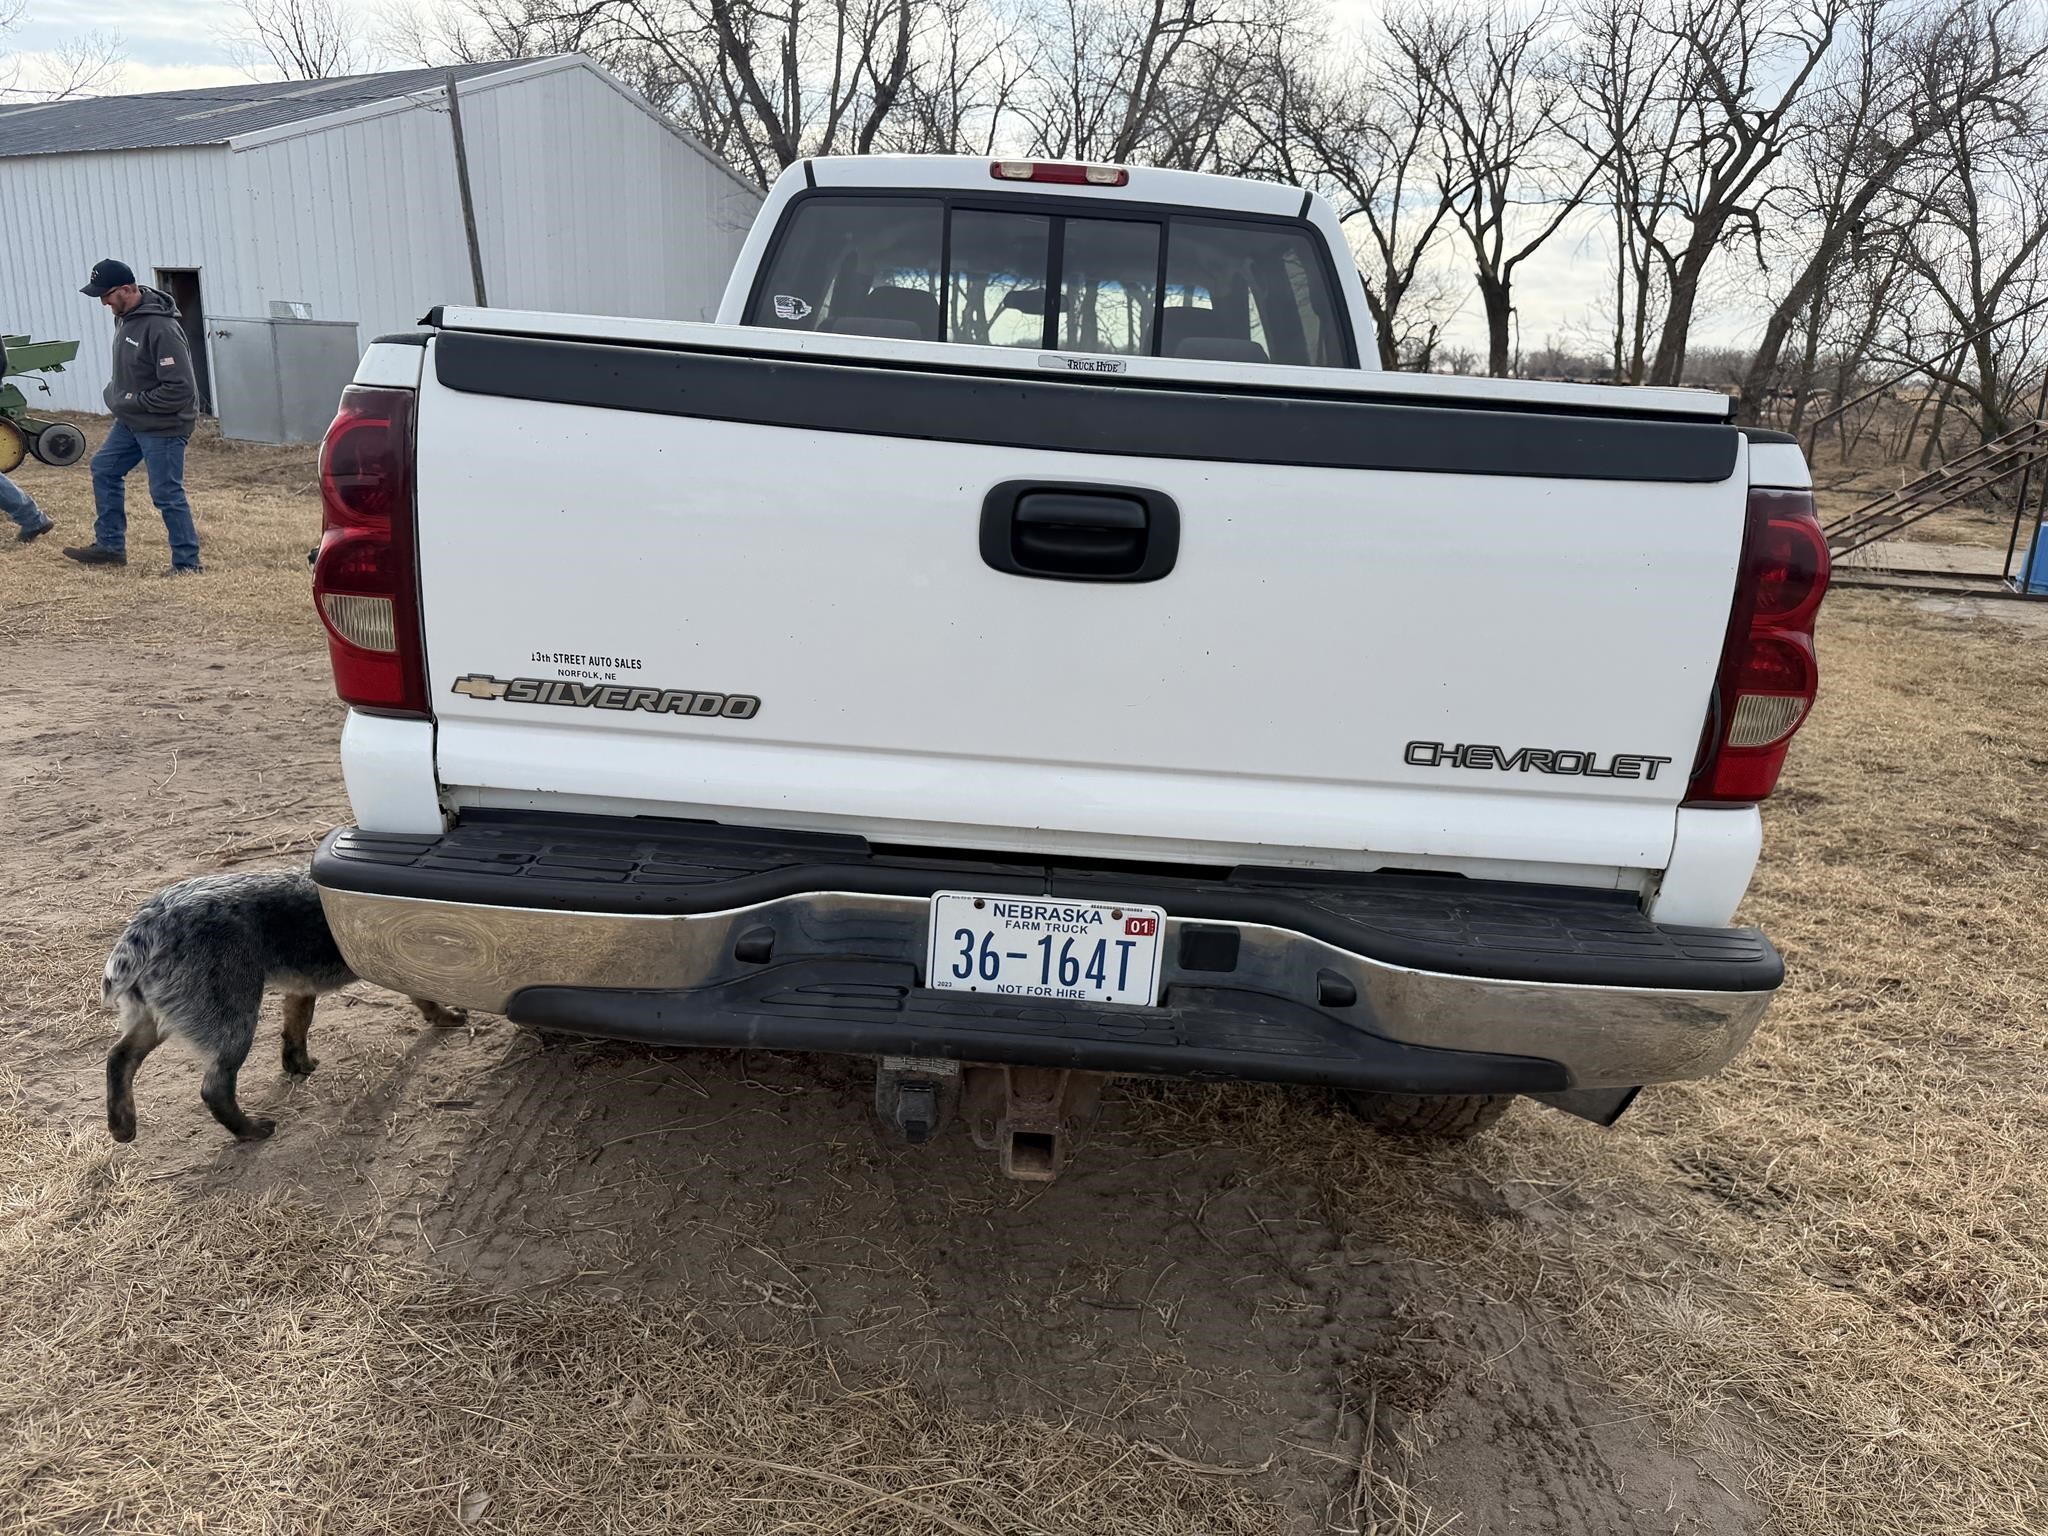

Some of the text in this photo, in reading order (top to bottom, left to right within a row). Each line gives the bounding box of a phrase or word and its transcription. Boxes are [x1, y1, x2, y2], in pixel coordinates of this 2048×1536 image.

[1067, 359, 1119, 373] TRUCK HYDE
[531, 651, 642, 670] 13th STREET AUTO SALES
[557, 669, 602, 680] NORFOLK,
[503, 677, 762, 719] SILVERADO
[1403, 740, 1672, 780] CHEVROLET
[993, 903, 1103, 925] NEBRASKA
[1005, 919, 1089, 935] FARM TRUCK
[1130, 920, 1149, 934] 01
[951, 928, 1137, 991] 36-164T
[997, 984, 1087, 999] NOT FOR HIRE
